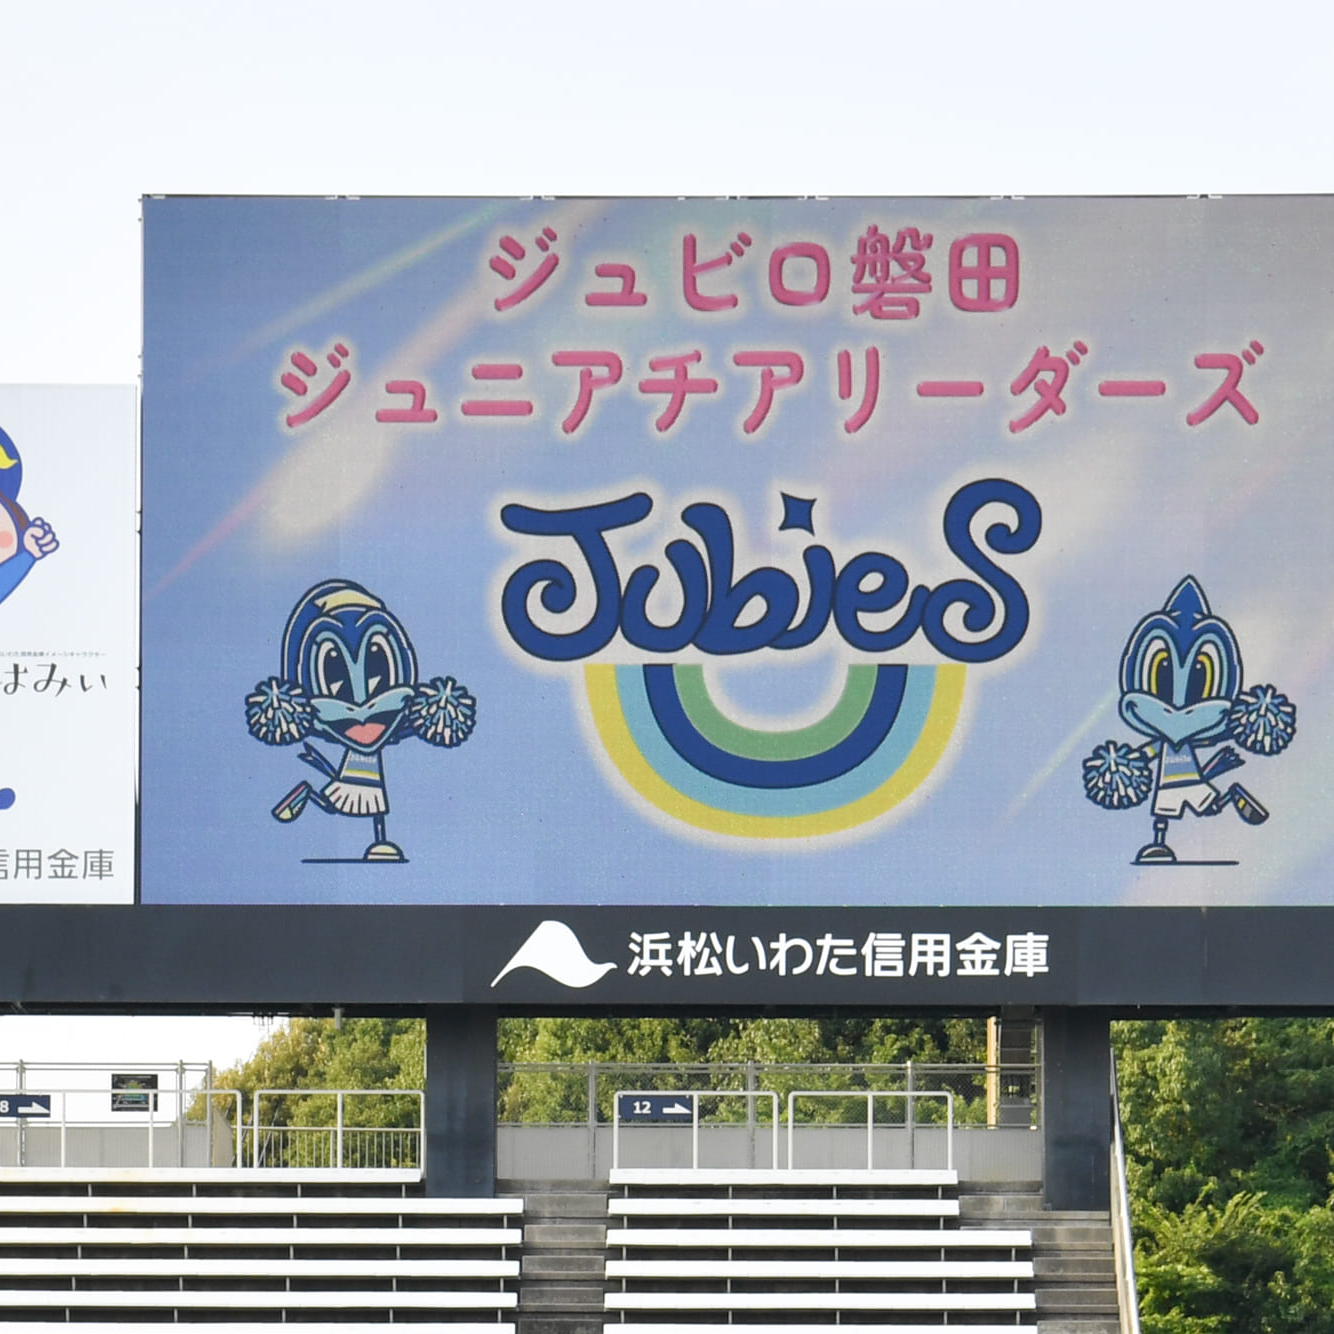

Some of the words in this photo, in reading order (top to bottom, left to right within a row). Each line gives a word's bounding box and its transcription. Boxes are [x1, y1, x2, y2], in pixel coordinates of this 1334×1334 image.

[487, 225, 1021, 322] ジュビロ磐田
[279, 340, 1265, 435] ジュニアチアリーダーズ
[627, 931, 1050, 980] 浜松いわた信用金庫
[633, 1101, 651, 1114] 12
